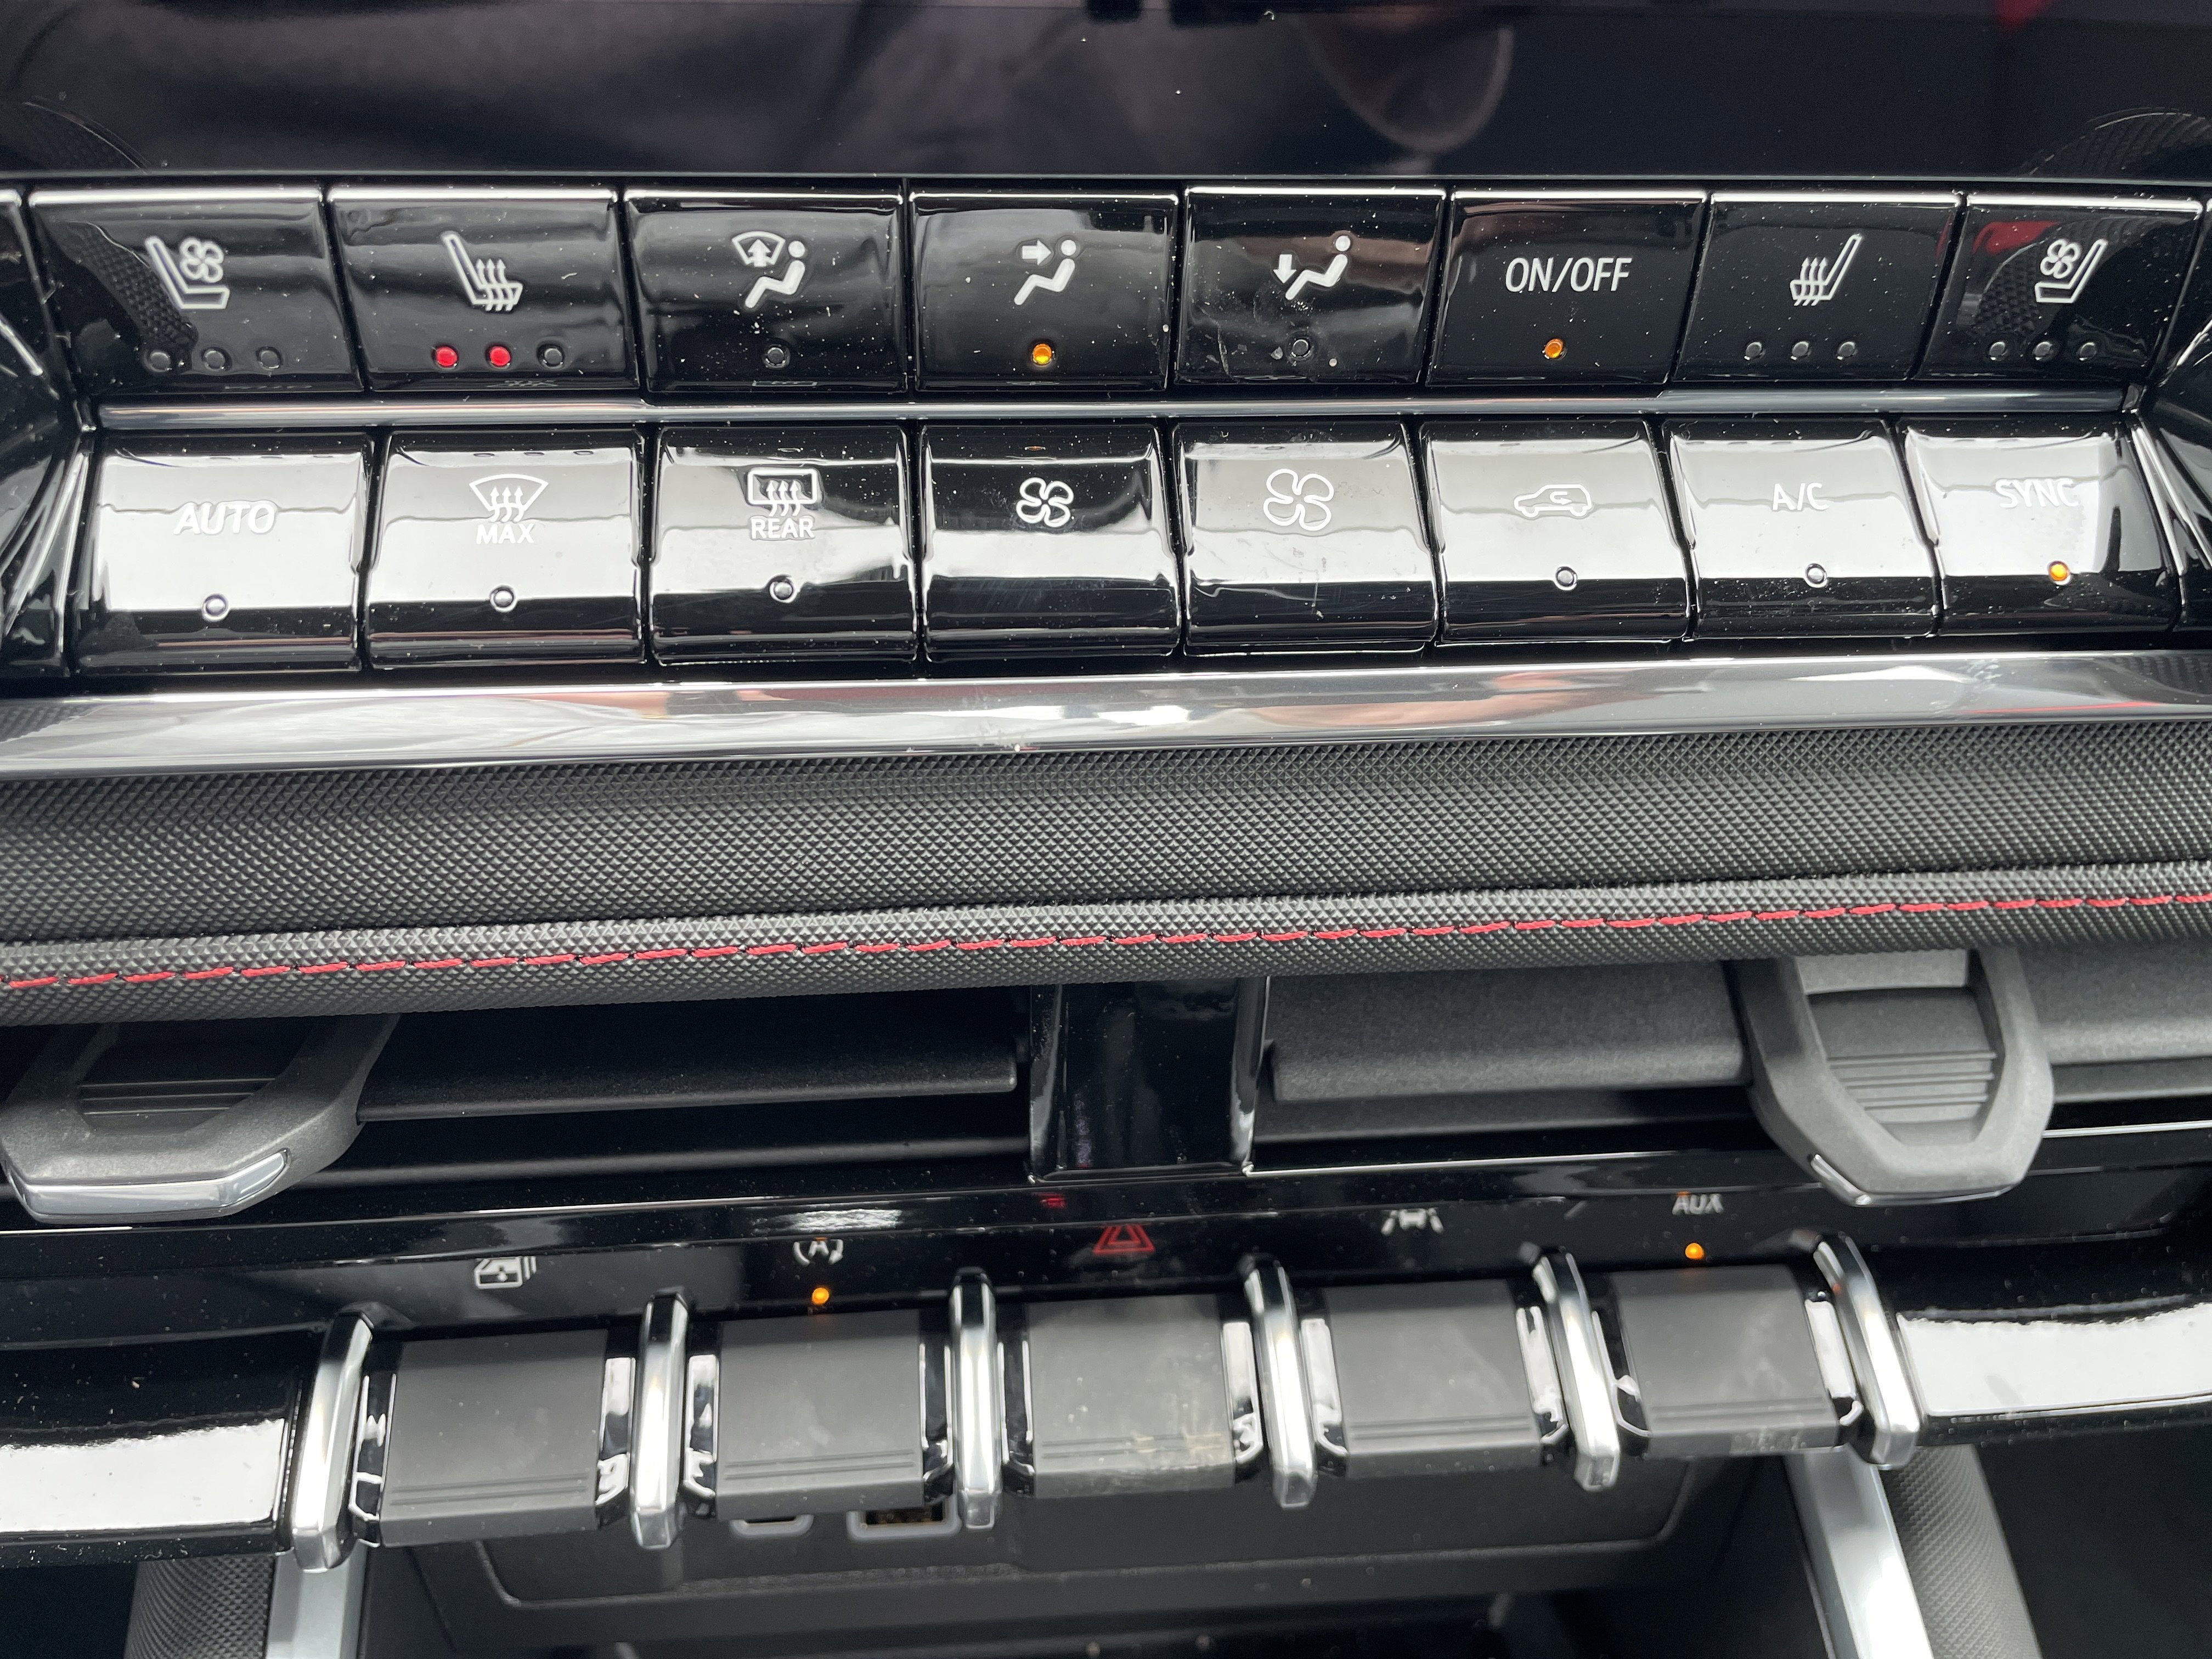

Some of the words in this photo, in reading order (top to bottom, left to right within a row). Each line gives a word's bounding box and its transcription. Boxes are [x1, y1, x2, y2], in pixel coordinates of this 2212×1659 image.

[1505, 257, 1633, 292] ON/OFF
[1772, 482, 1830, 511] A/C
[1995, 478, 2079, 508] SYNC
[173, 501, 276, 535] AUTO
[750, 517, 815, 539] REAR
[476, 523, 534, 544] MAX
[1672, 1192, 1724, 1215] AUX
